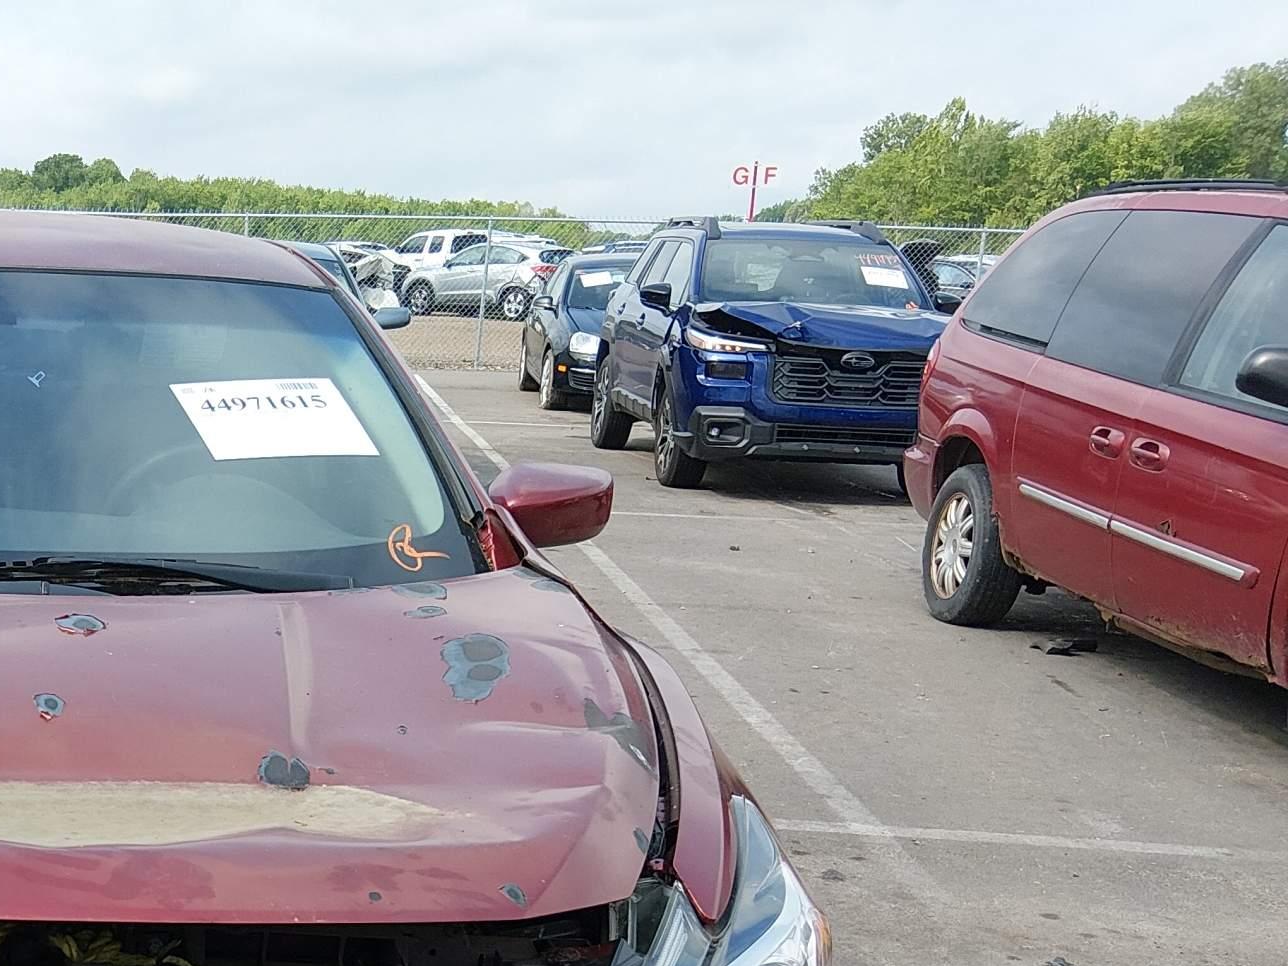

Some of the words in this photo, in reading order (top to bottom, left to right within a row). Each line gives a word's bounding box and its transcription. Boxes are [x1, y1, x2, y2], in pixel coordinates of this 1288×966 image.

[733, 166, 749, 185] G
[764, 166, 778, 185] F
[200, 395, 327, 412] 44971615
